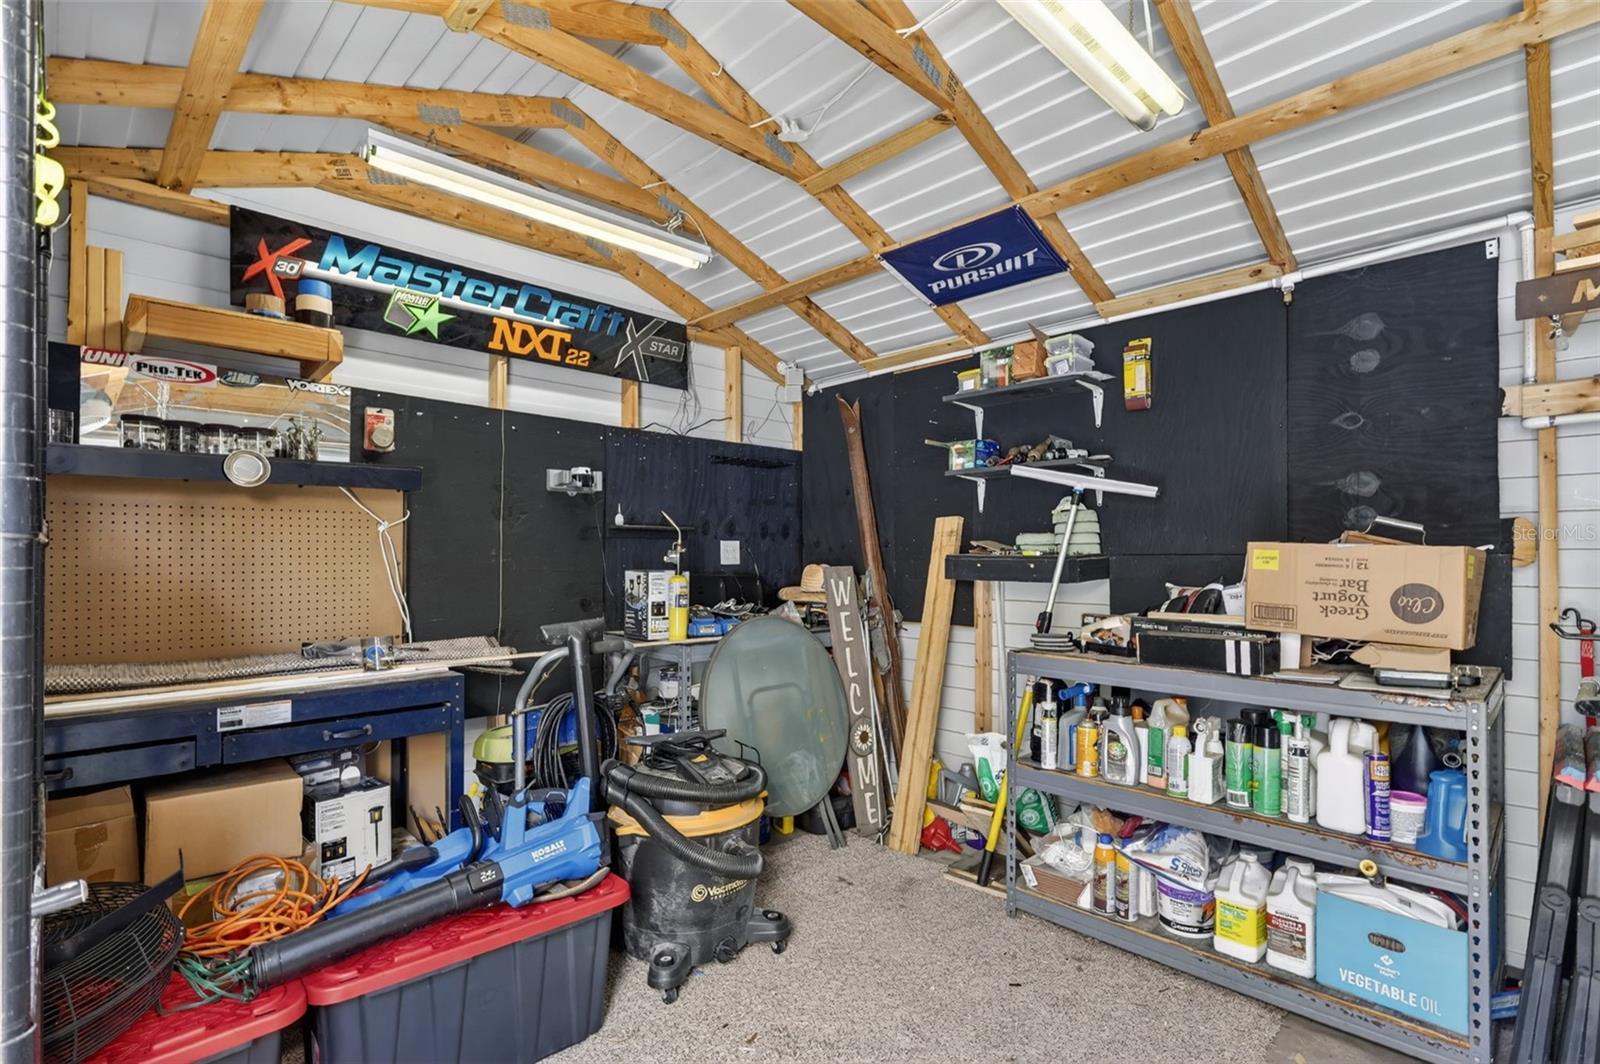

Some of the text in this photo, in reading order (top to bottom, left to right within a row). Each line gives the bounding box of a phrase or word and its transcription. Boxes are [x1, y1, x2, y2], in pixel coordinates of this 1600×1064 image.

[275, 260, 300, 276] 30
[927, 247, 1039, 294] PURSUIT
[317, 234, 626, 336] MasterCraft
[488, 317, 591, 367] NXT 22
[648, 340, 679, 356] STAR
[84, 350, 125, 366] UNI
[1355, 561, 1369, 570] 12
[1339, 579, 1369, 592] Bar
[1312, 590, 1370, 607] Yogurt
[1397, 594, 1436, 614] Clio
[1319, 605, 1369, 620] Greek
[1338, 967, 1418, 1008] VEGETABLE
[1420, 996, 1442, 1017] OIL
